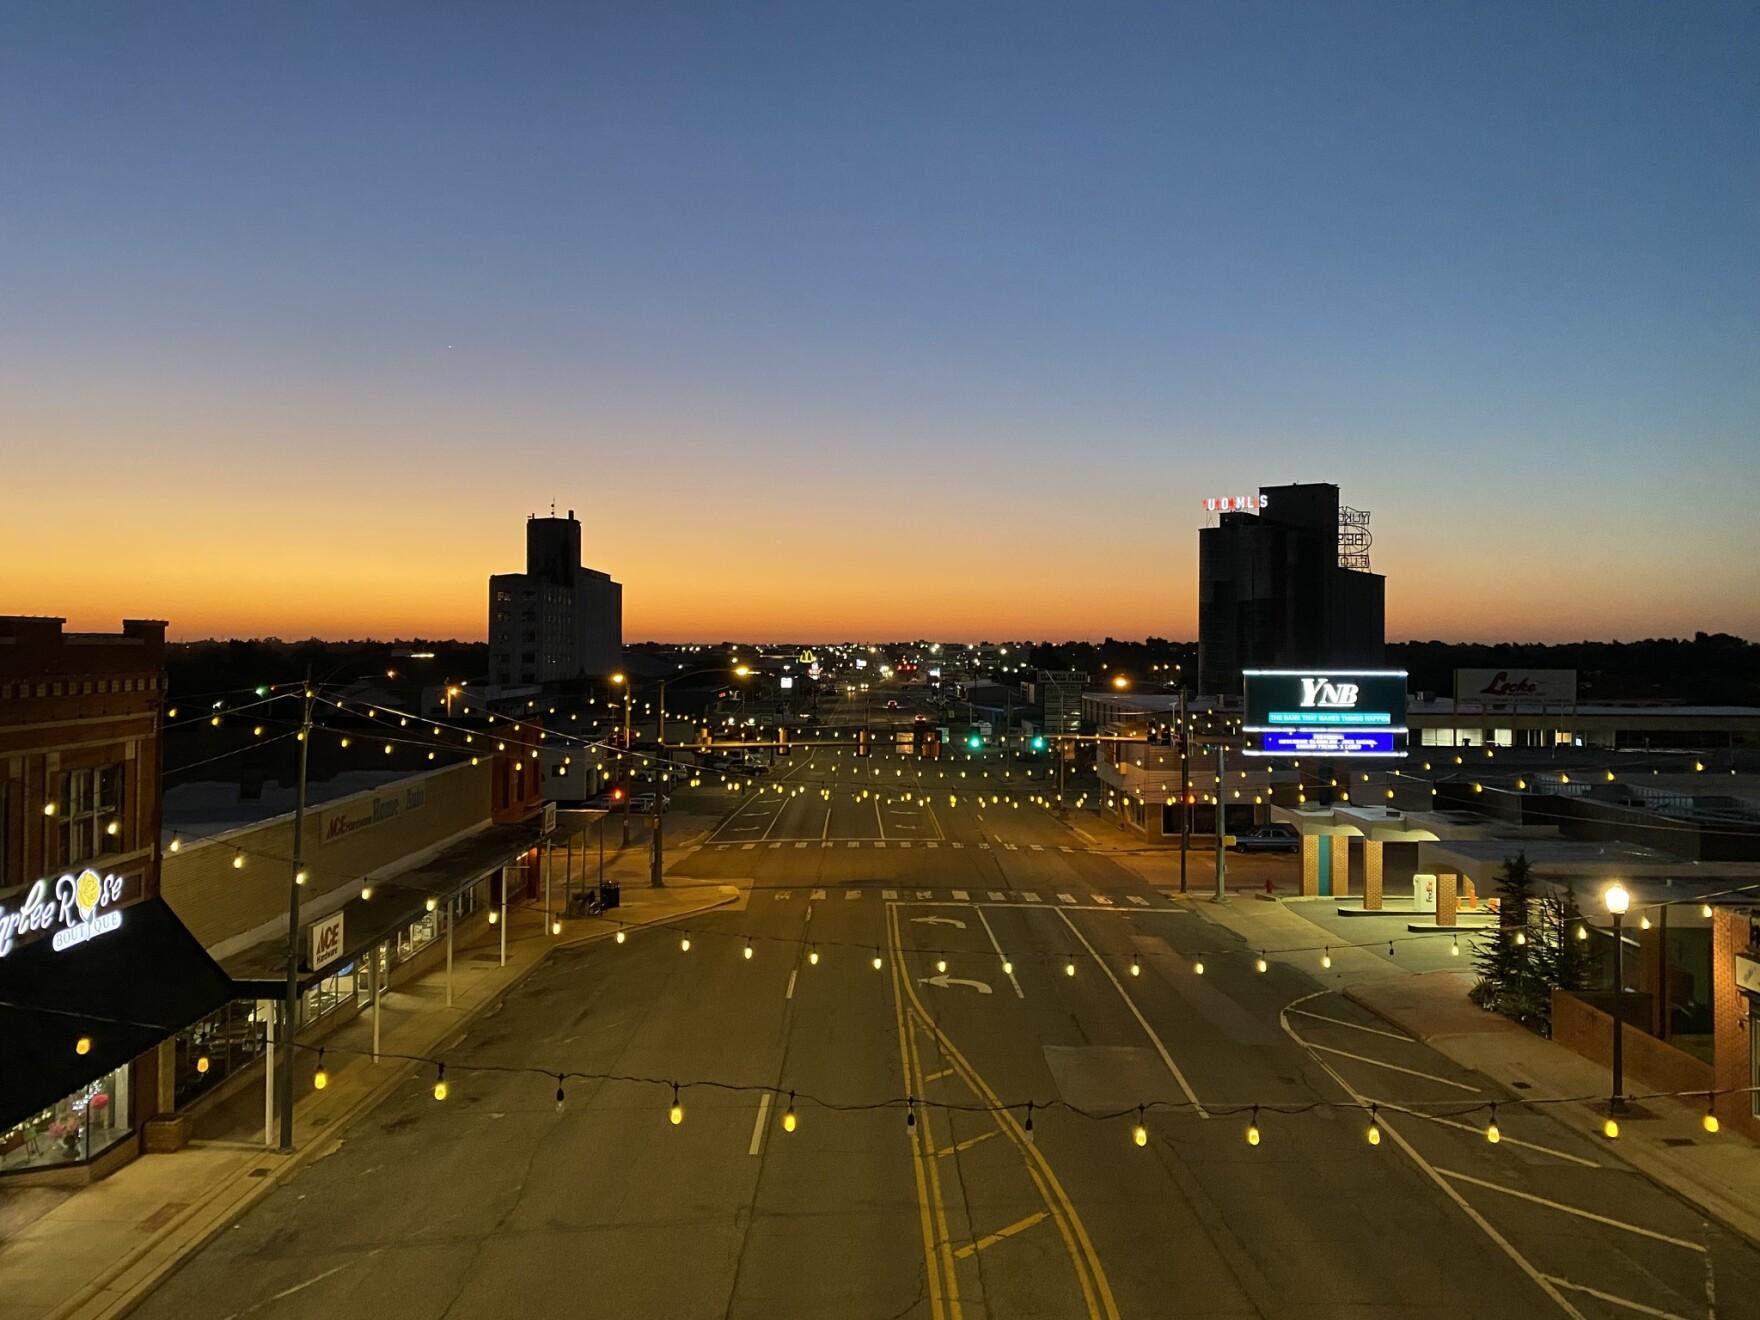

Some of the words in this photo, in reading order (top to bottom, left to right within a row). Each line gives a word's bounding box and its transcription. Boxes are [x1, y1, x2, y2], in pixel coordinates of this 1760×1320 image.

[1300, 678, 1359, 707] YNB
[1480, 671, 1537, 696] Locke
[316, 922, 340, 955] ACE
